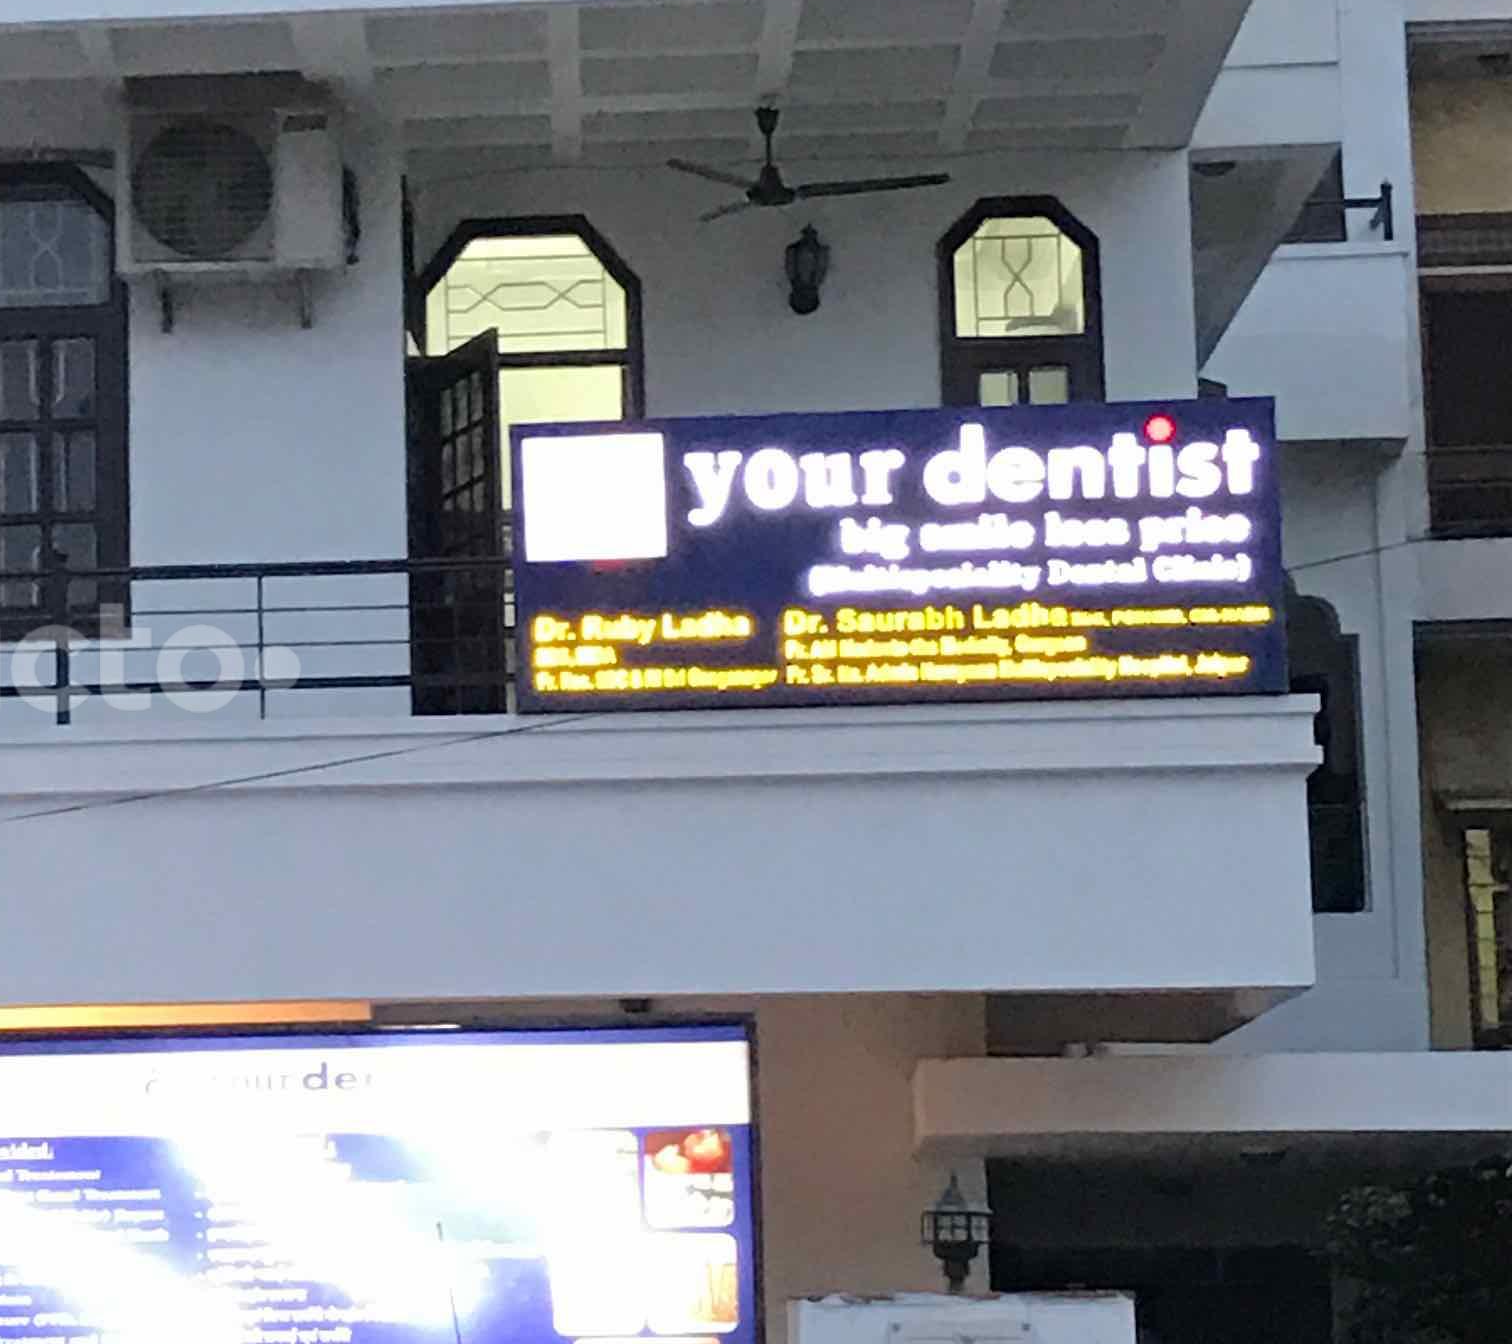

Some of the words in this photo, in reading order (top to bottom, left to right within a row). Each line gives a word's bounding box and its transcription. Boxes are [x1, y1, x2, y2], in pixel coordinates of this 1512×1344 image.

[683, 448, 905, 526] your
[922, 415, 1259, 505] dentist
[840, 517, 909, 559] big
[920, 514, 1035, 550] smile
[1140, 507, 1250, 551] price
[1048, 558, 1147, 584] Dental
[535, 616, 576, 642] Dr.
[784, 609, 829, 636] Dr.
[837, 605, 965, 633] Saurabh
